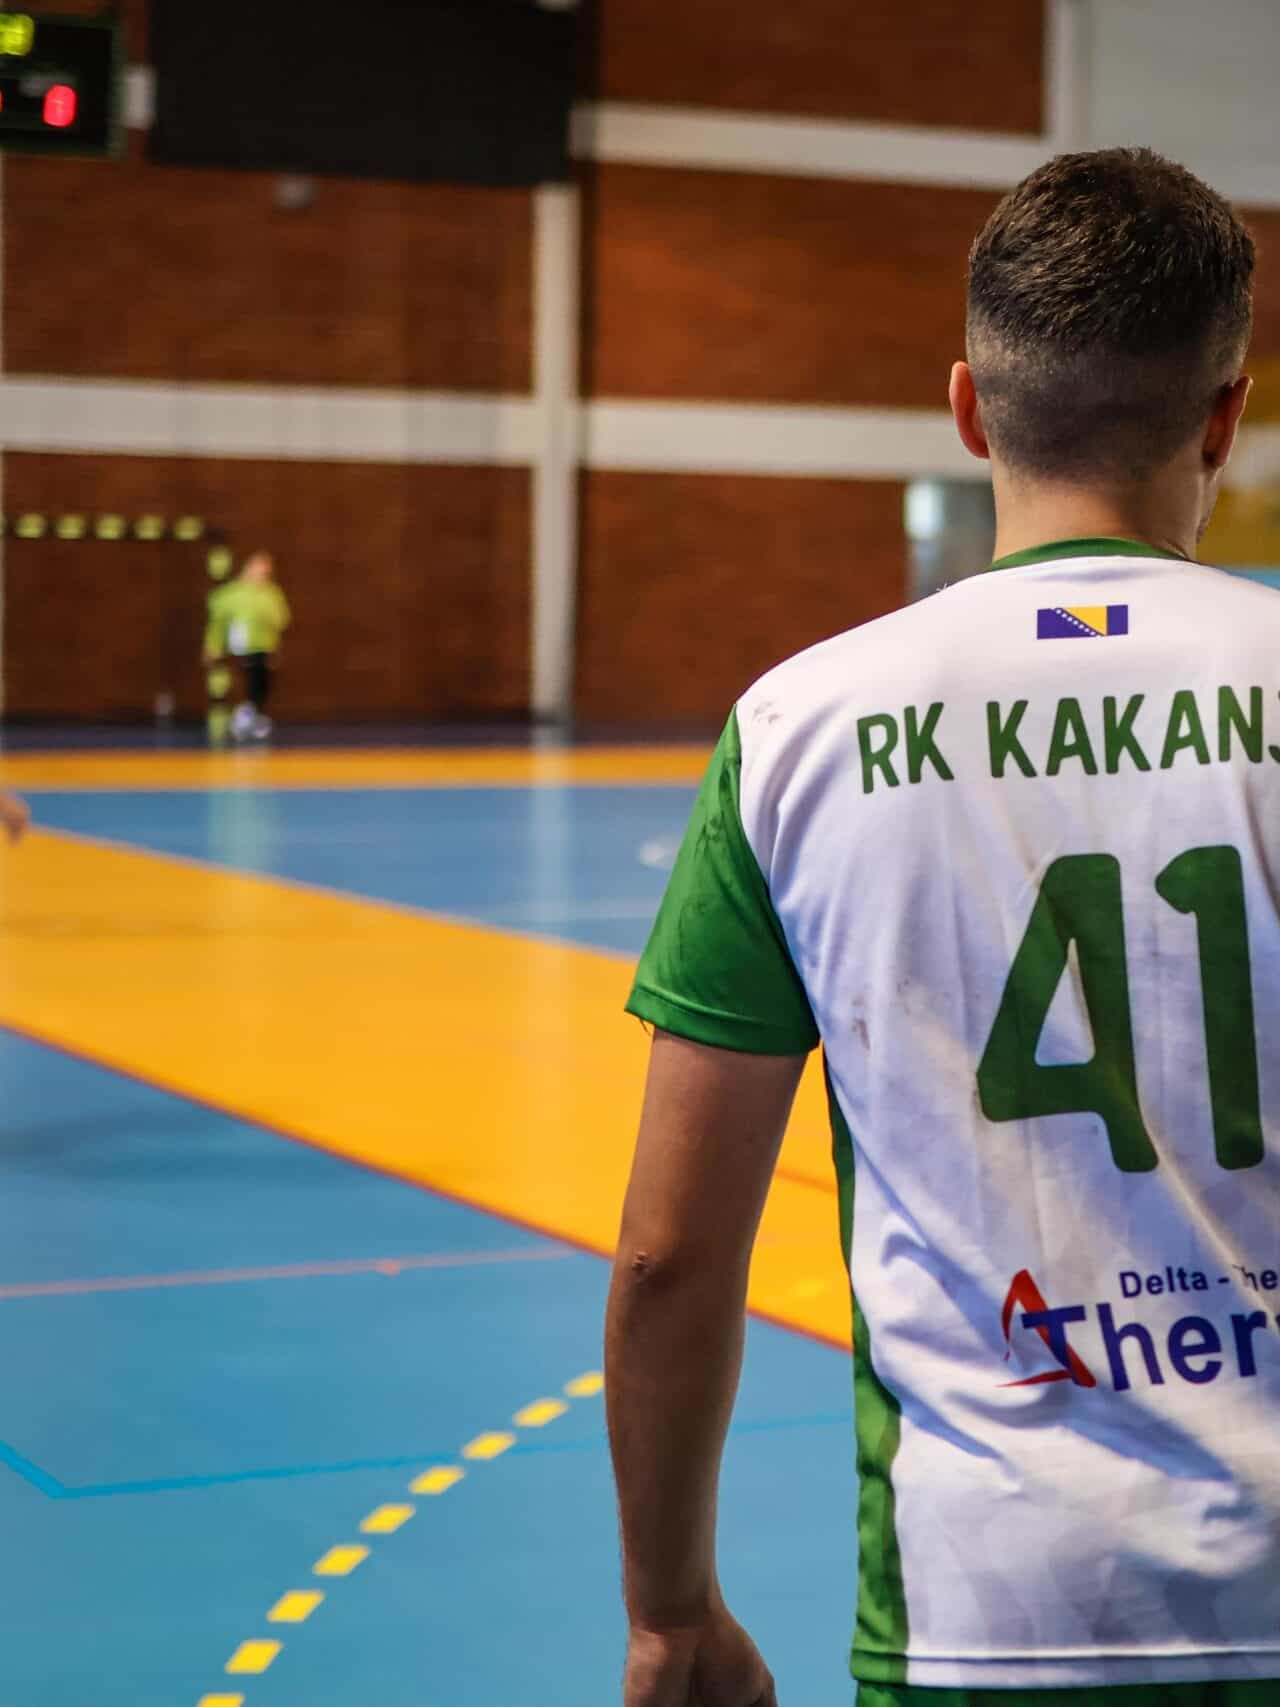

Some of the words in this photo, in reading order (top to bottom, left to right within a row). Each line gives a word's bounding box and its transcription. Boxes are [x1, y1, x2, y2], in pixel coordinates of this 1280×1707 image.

[857, 701, 955, 794] RK
[976, 844, 1265, 1172] 41
[1119, 1266, 1209, 1299] Delta
